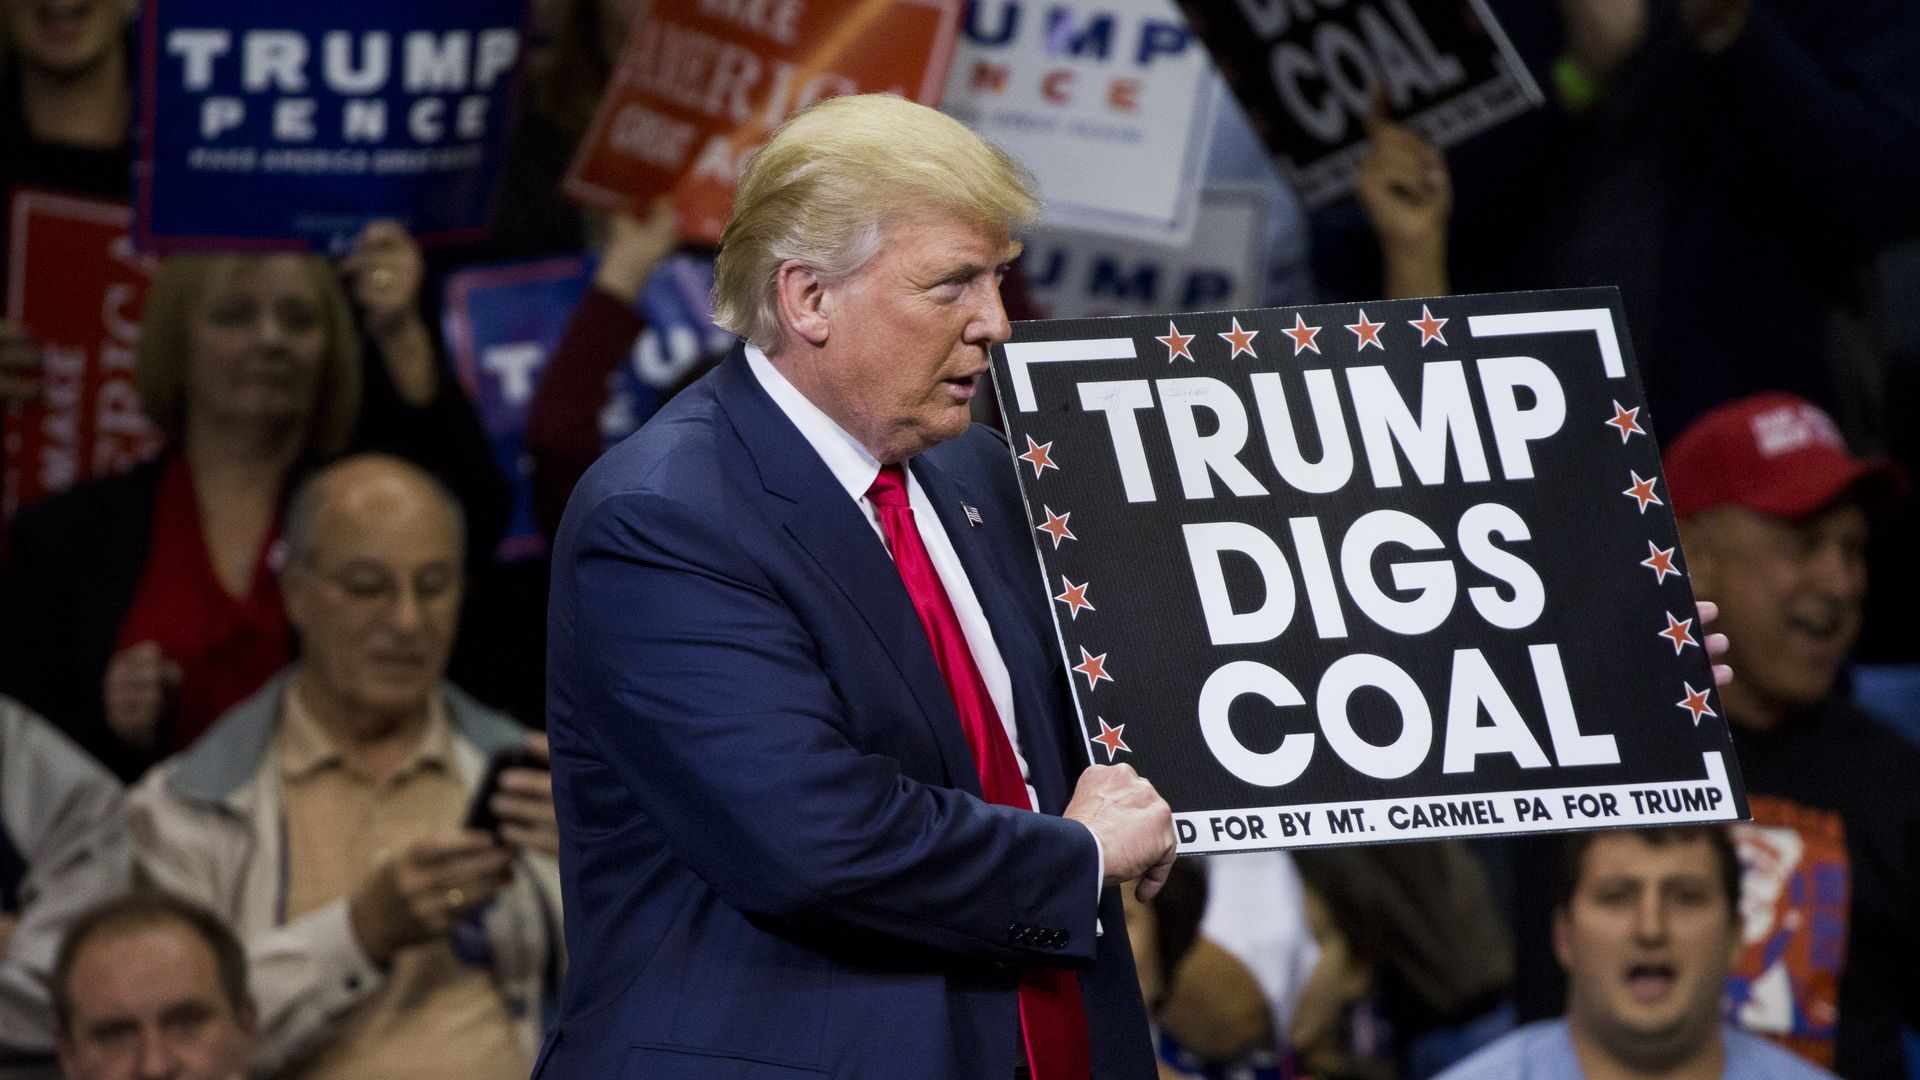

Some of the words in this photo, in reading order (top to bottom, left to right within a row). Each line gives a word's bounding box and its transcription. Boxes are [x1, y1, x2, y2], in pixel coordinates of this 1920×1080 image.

[166, 29, 519, 94] TRUMP
[201, 97, 488, 140] PENCE
[1269, 0, 1466, 143] COAL
[1077, 357, 1567, 503] TRUMP
[1182, 503, 1546, 646] DIGS
[1199, 644, 1621, 788] COAL
[1175, 819, 1198, 844] D
[1210, 815, 1268, 842] FOR
[1278, 812, 1312, 838] BY
[1326, 808, 1376, 835] MT.
[1387, 799, 1505, 830] CARMEL
[1513, 797, 1553, 823] PA
[1562, 792, 1621, 819] FOR
[1629, 787, 1723, 815] TRUMP
